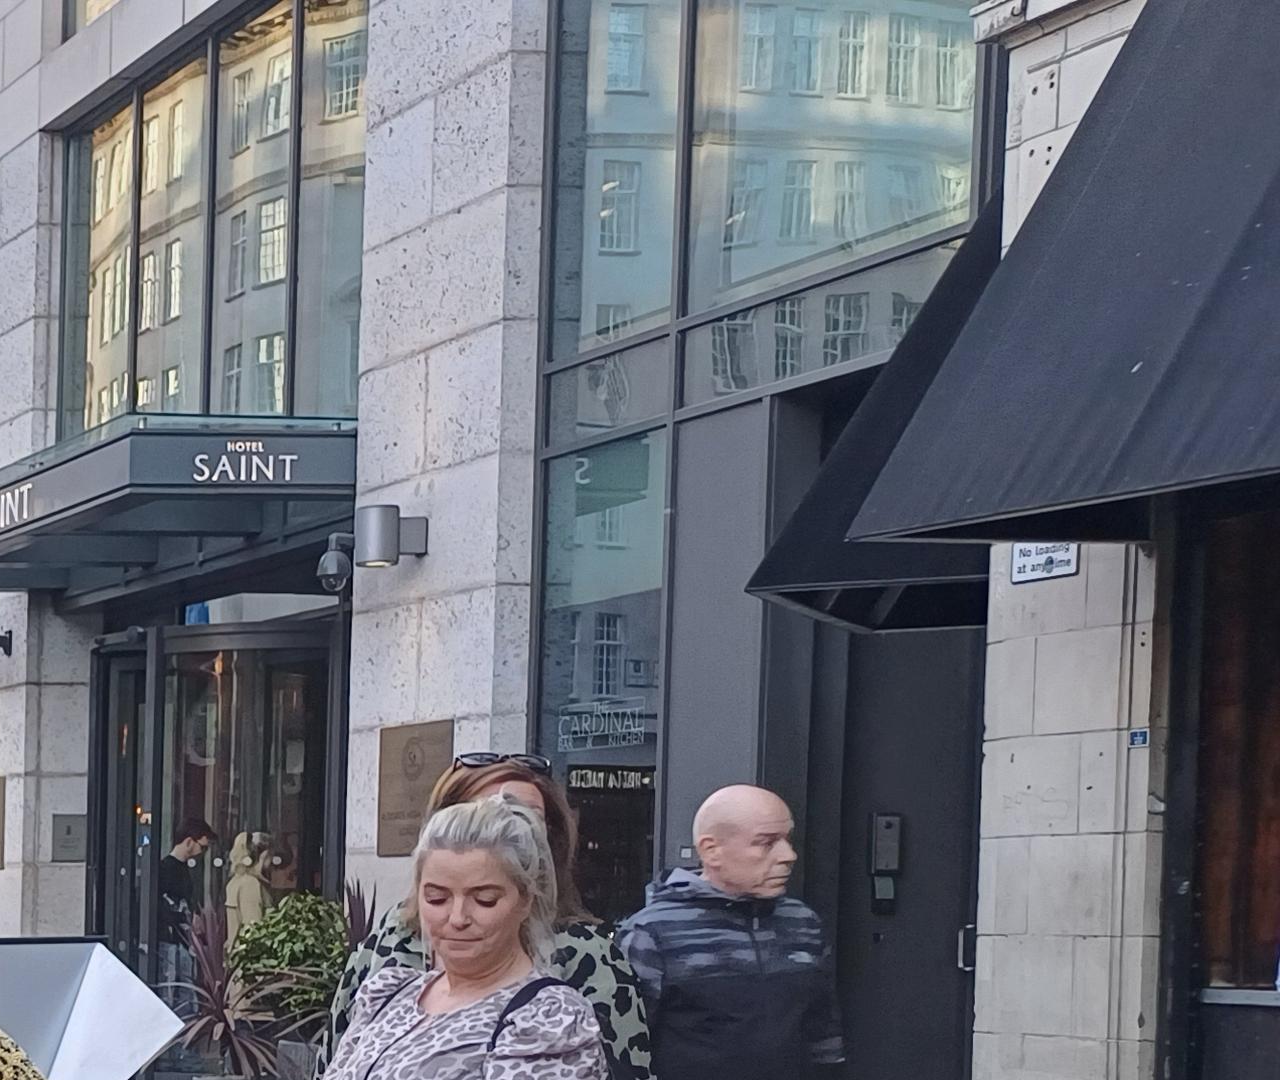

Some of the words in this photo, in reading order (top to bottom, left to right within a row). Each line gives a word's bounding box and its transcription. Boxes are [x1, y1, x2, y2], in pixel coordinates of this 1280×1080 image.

[227, 442, 264, 452] HOTEL
[193, 454, 298, 481] SAINT
[1019, 547, 1032, 558] No
[1017, 564, 1026, 573] at
[559, 708, 645, 738] CARDINAL
[608, 728, 644, 746] KITCHEN
